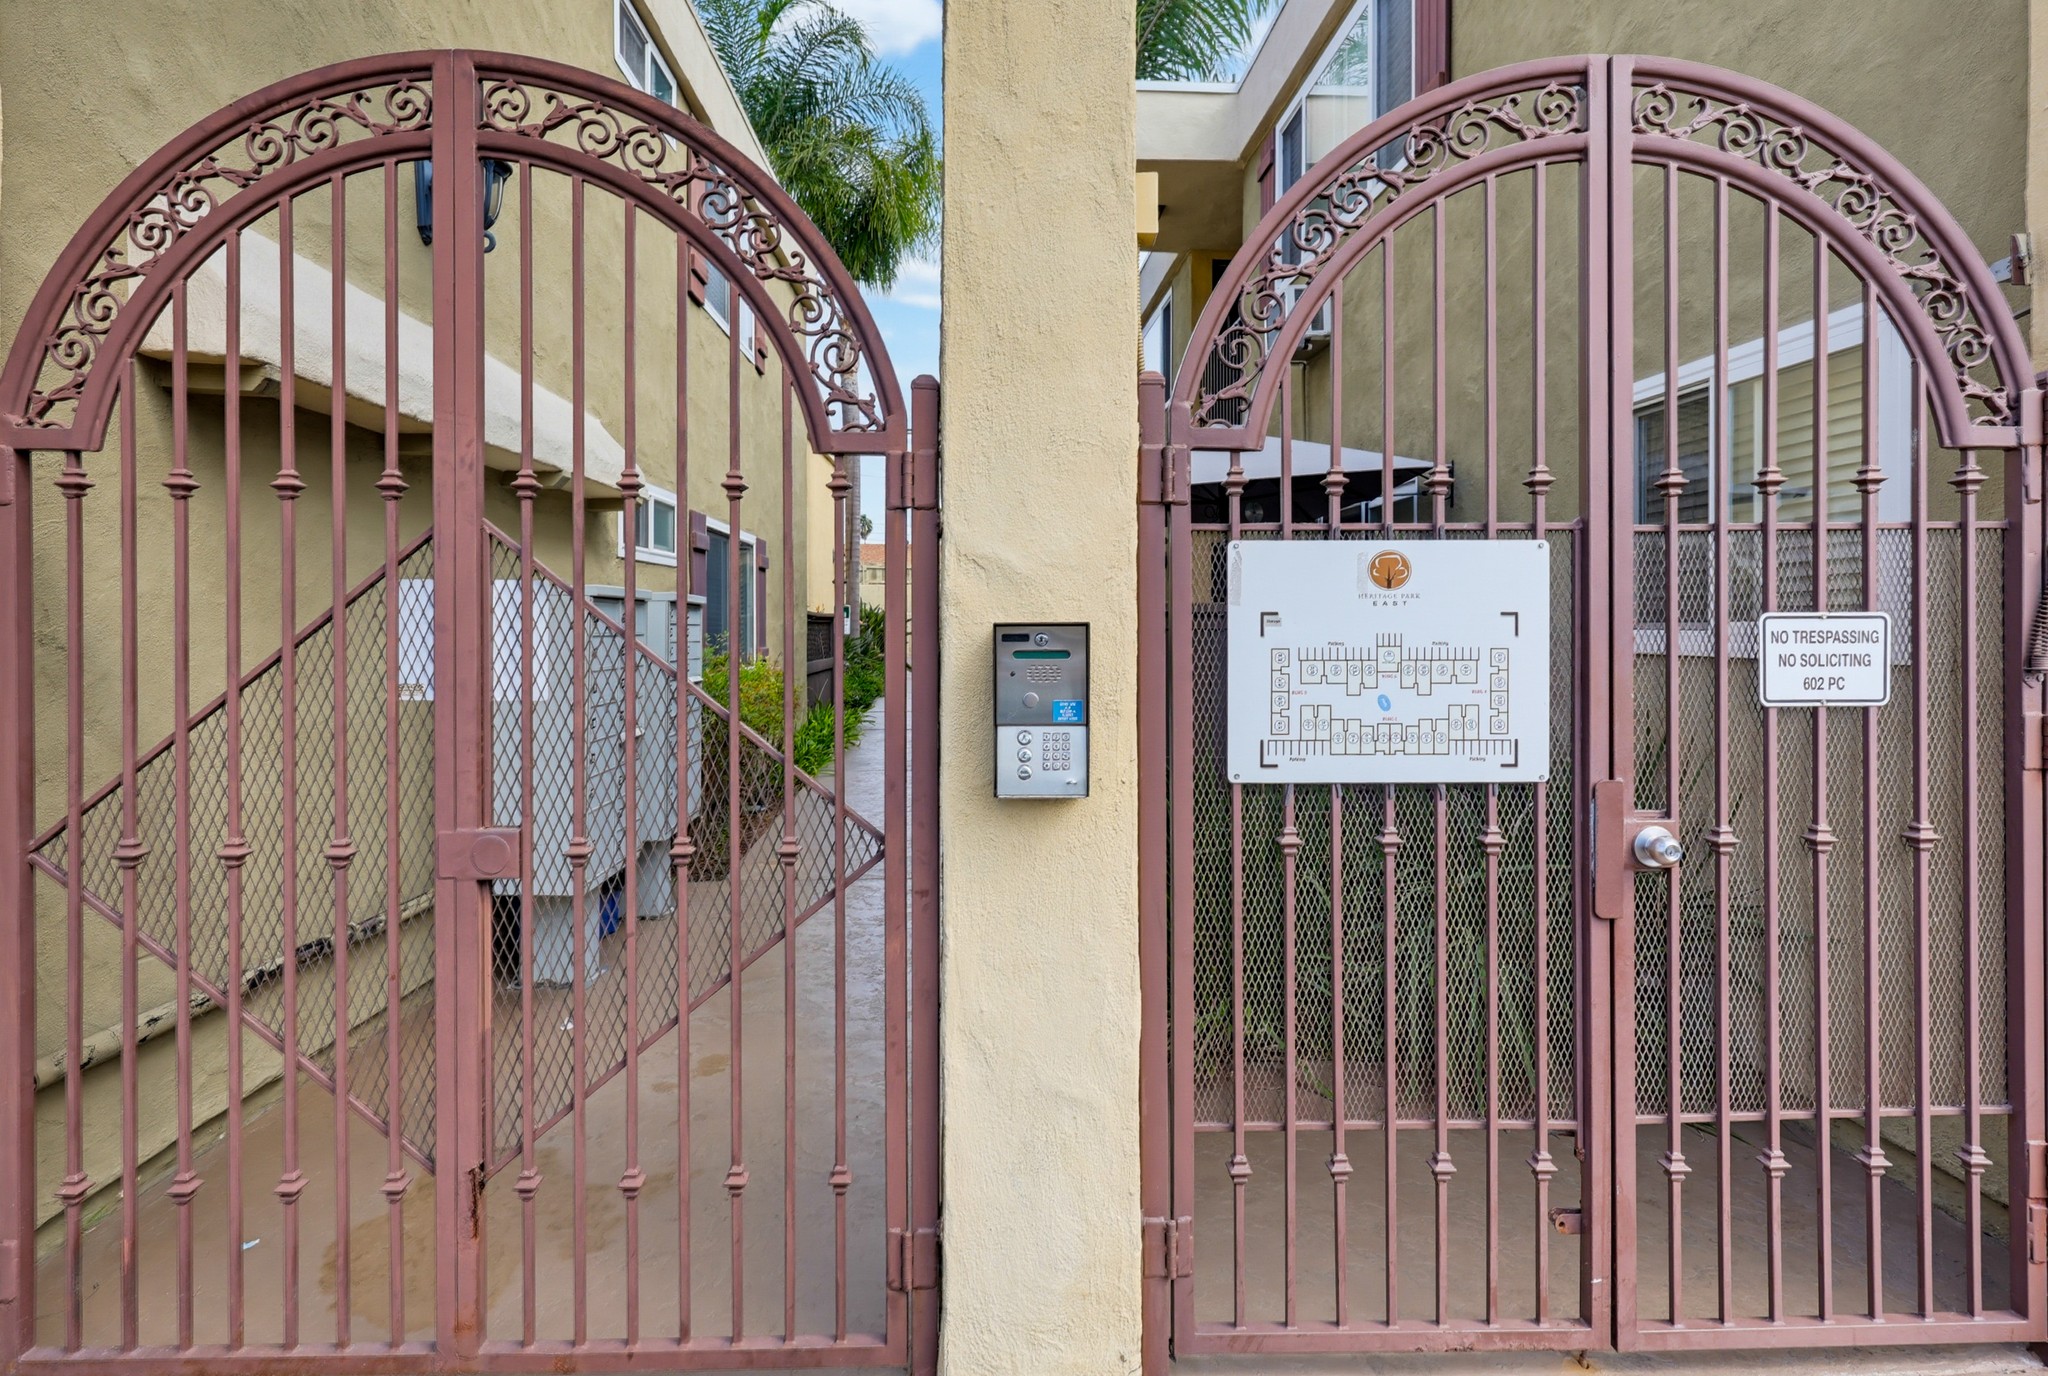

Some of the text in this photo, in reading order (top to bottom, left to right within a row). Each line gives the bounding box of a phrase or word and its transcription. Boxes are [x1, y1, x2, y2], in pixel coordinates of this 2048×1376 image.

[1770, 630, 1880, 644] NO TRESPASSING
[1778, 653, 1872, 667] NO SOLICITING
[1803, 676, 1845, 691] 602 PC
